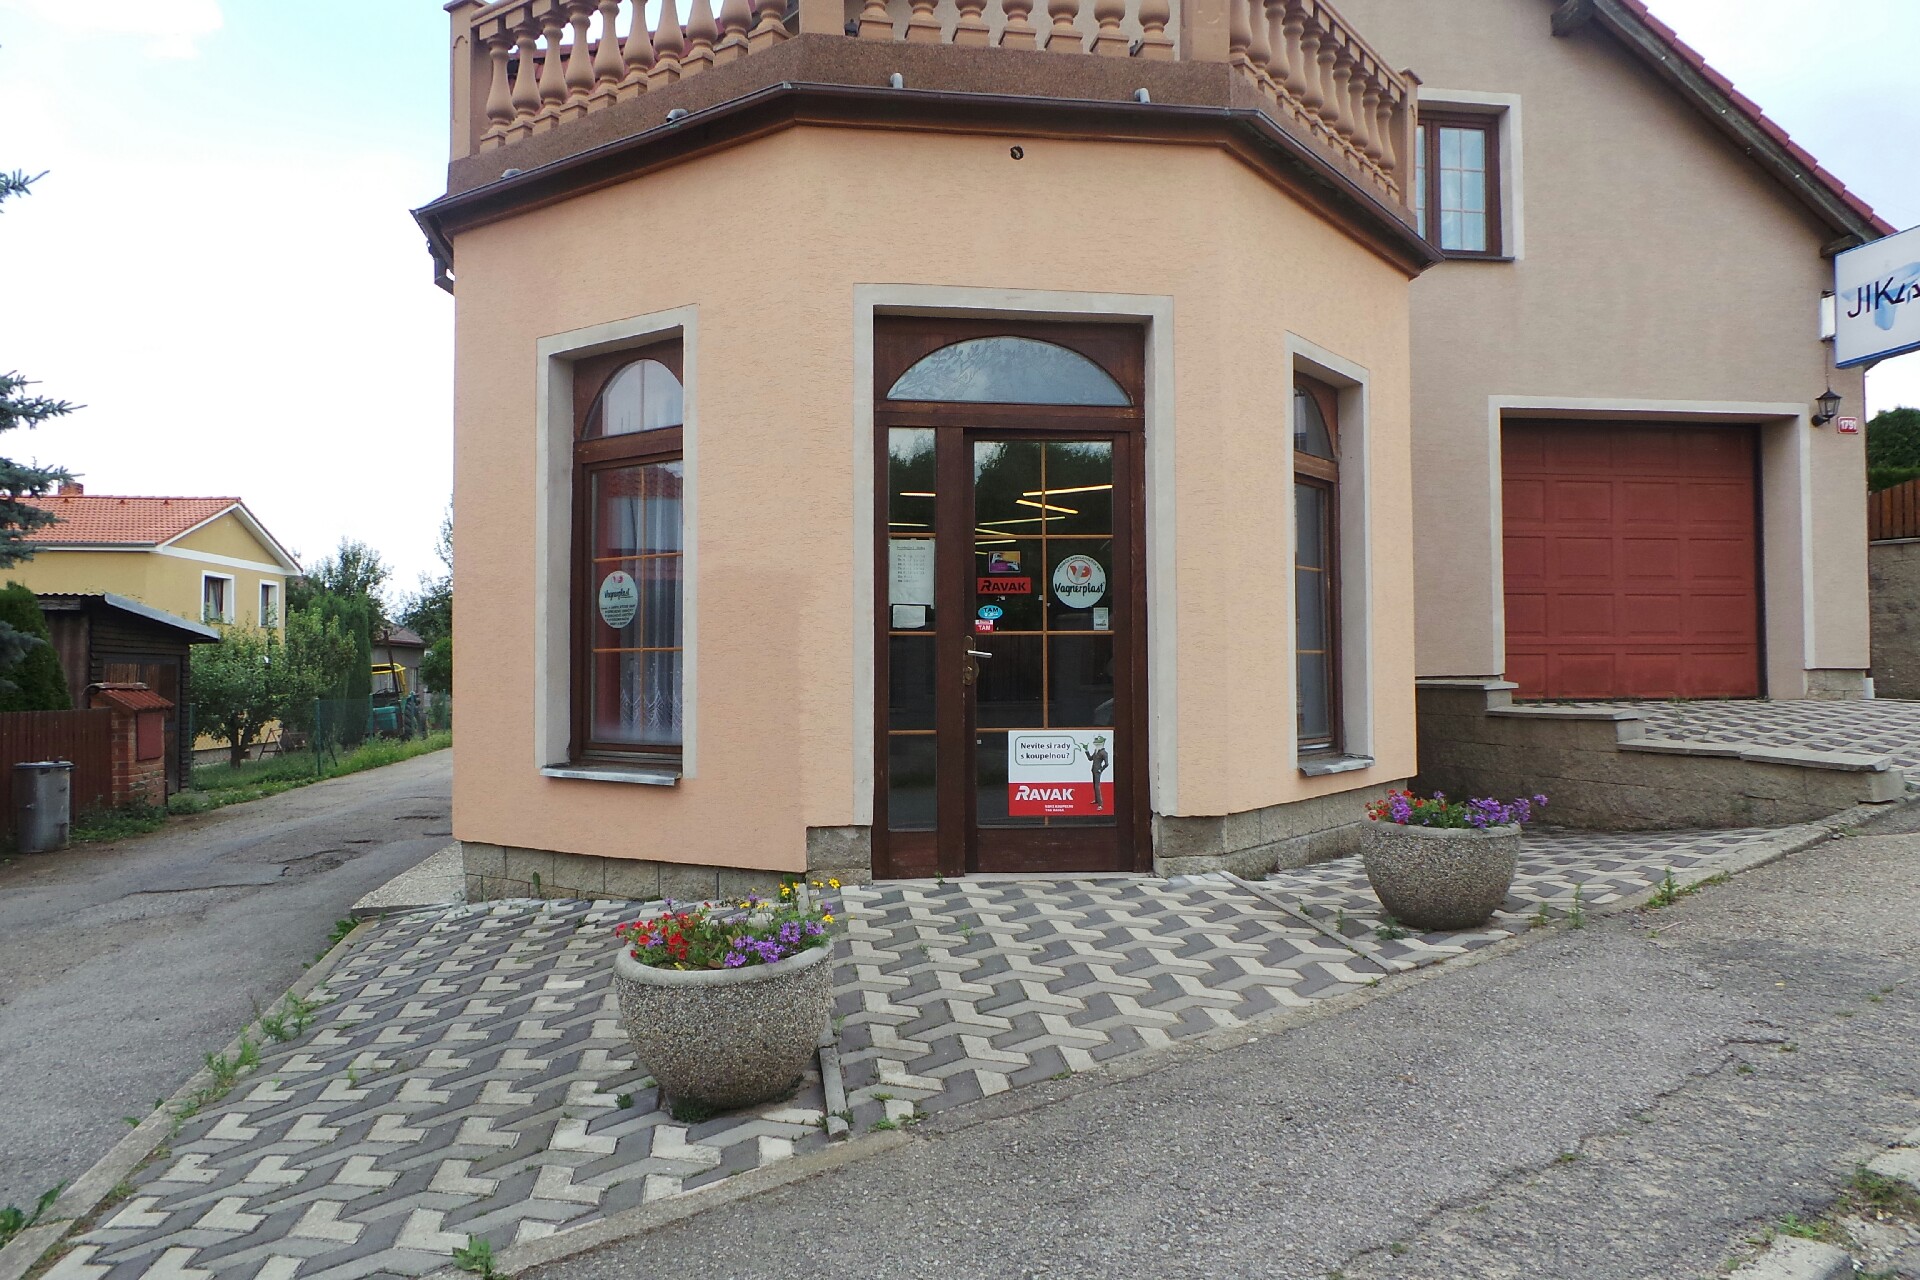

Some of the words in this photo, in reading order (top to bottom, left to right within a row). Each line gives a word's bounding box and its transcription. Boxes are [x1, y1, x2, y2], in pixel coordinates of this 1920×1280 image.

[1055, 582, 1104, 597] Vagnerplast
[1053, 742, 1071, 751] rady
[1026, 752, 1070, 760] koupelnou?
[1015, 785, 1074, 801] RAVAK
